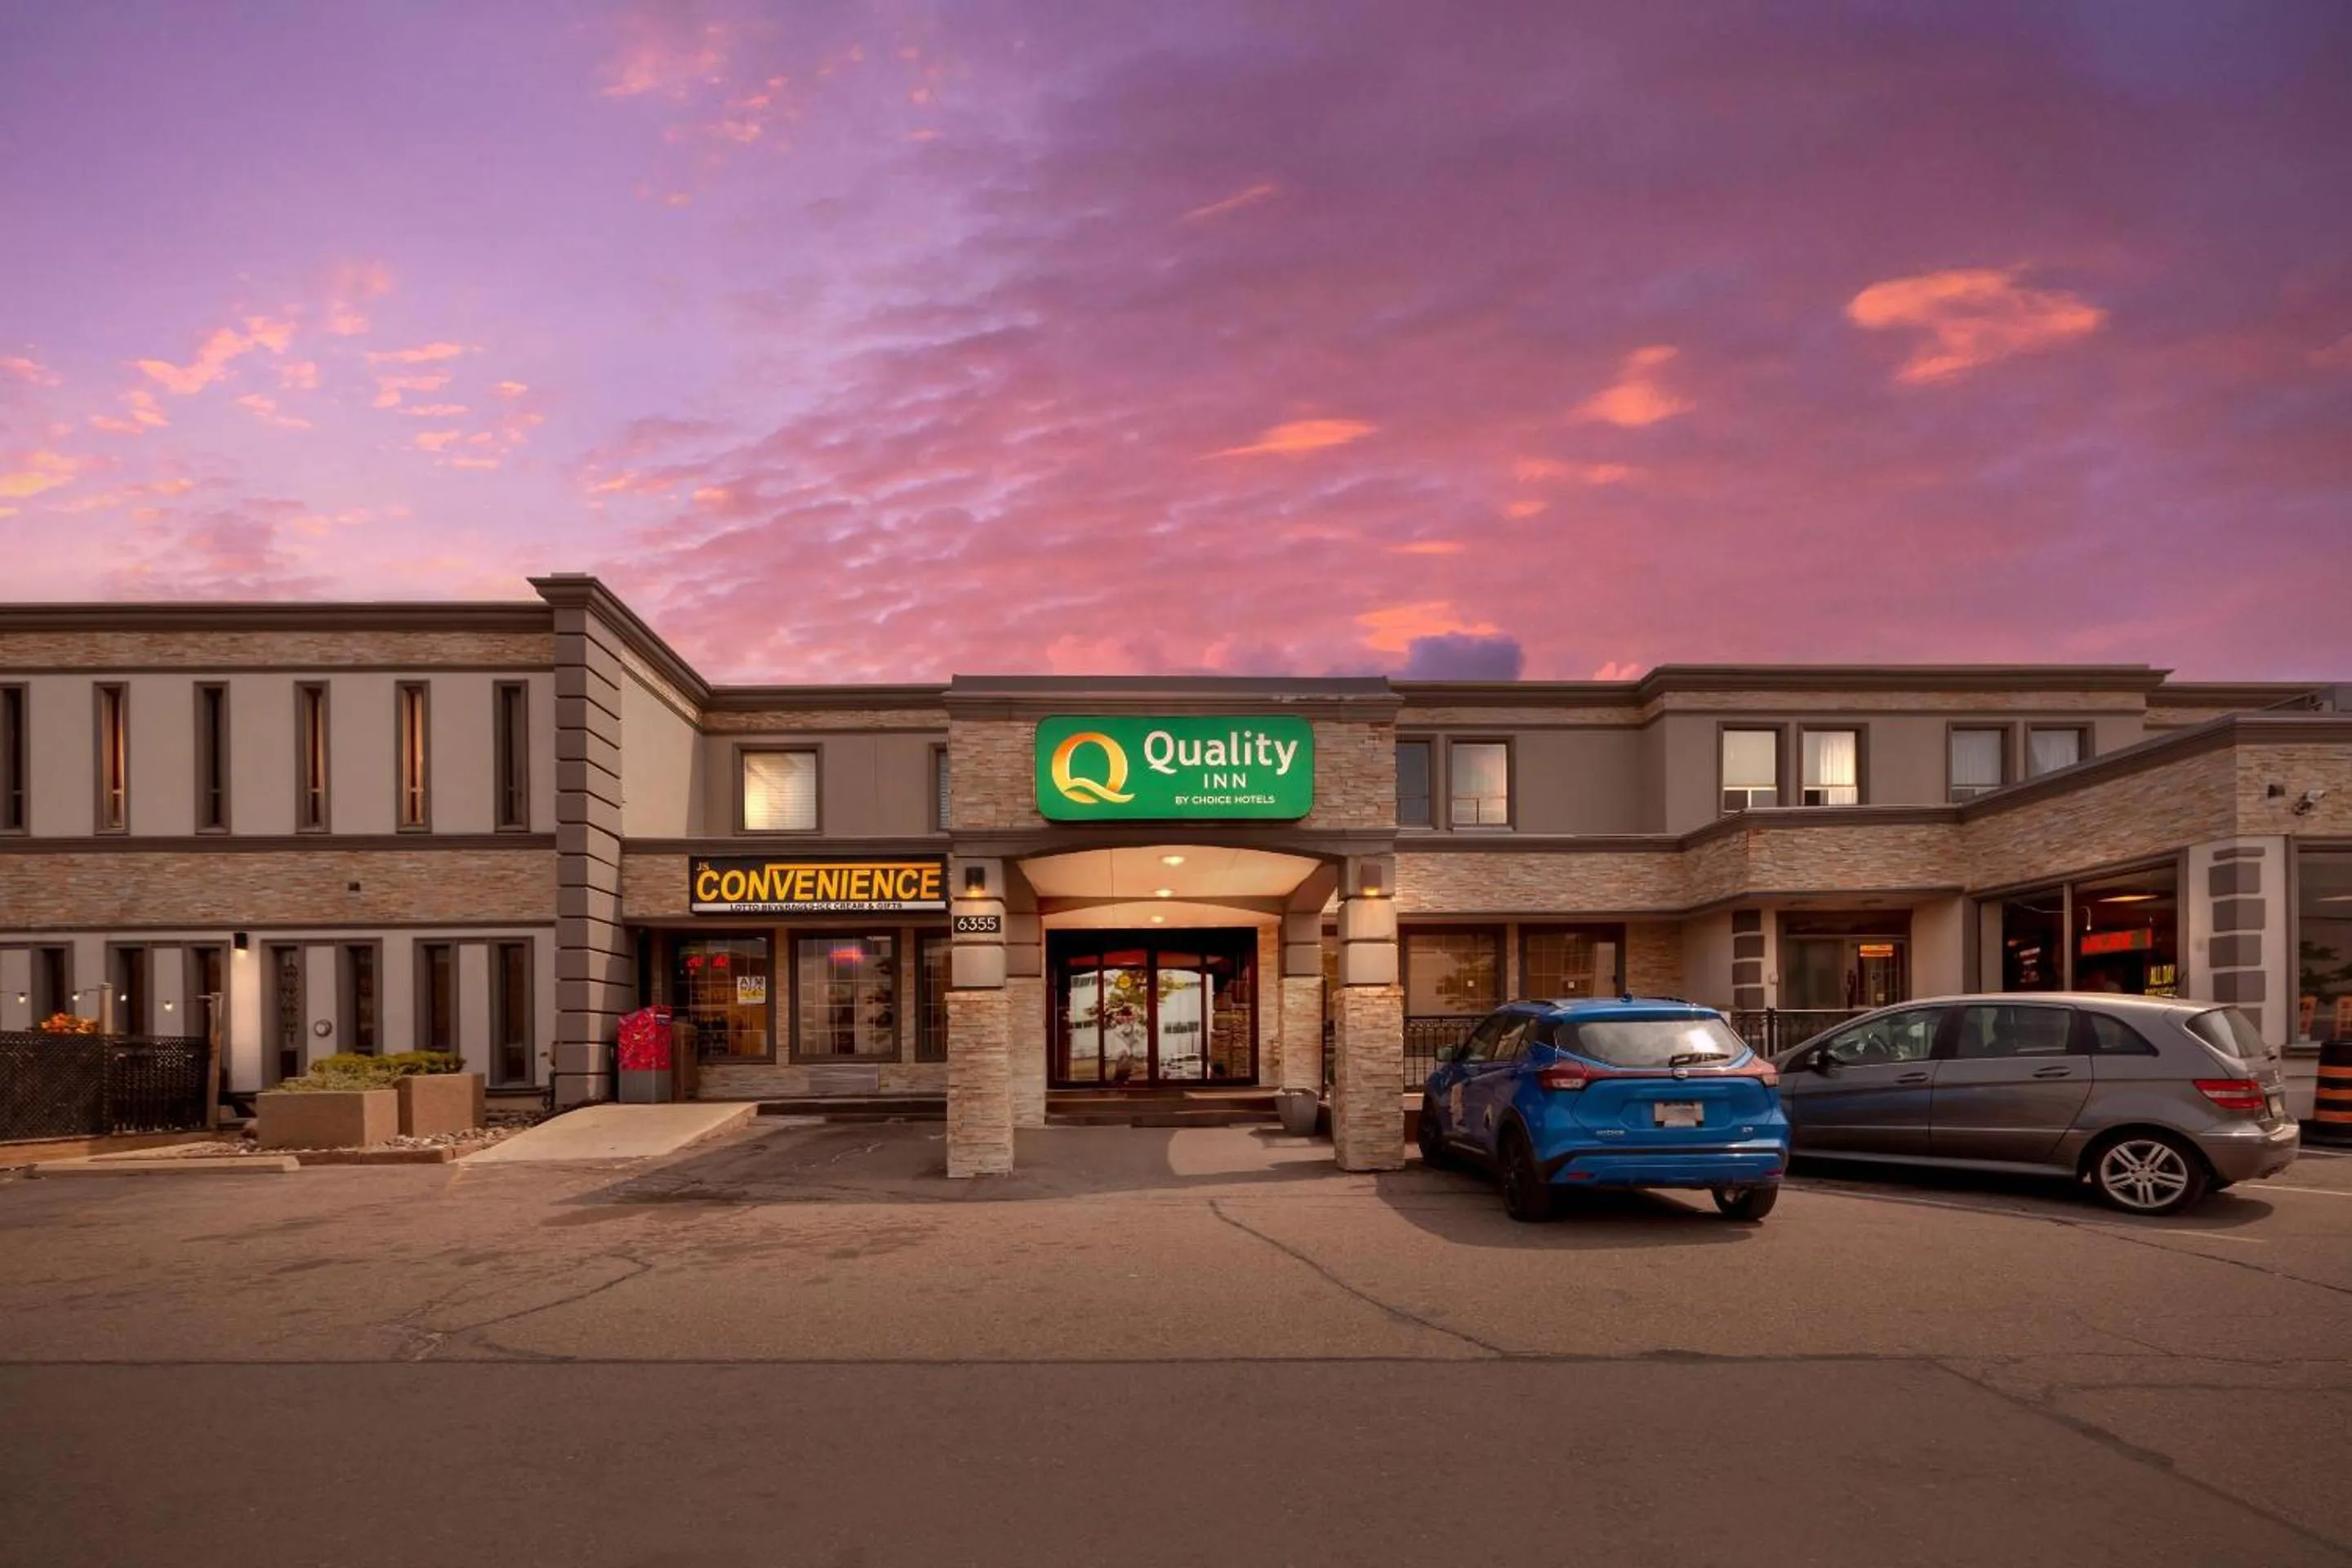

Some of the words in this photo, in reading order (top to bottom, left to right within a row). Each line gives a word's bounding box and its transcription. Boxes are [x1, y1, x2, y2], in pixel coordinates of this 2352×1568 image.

[1143, 730, 1298, 775] Quality
[1051, 731, 1135, 804] Q
[1204, 773, 1247, 789] INN
[1175, 795, 1189, 804] BY
[1192, 795, 1232, 804] CHOICE
[1234, 795, 1276, 804] HOTELS
[696, 864, 942, 901] CONVENIENCE
[730, 903, 760, 911] LOTTO
[957, 916, 996, 931] 6355
